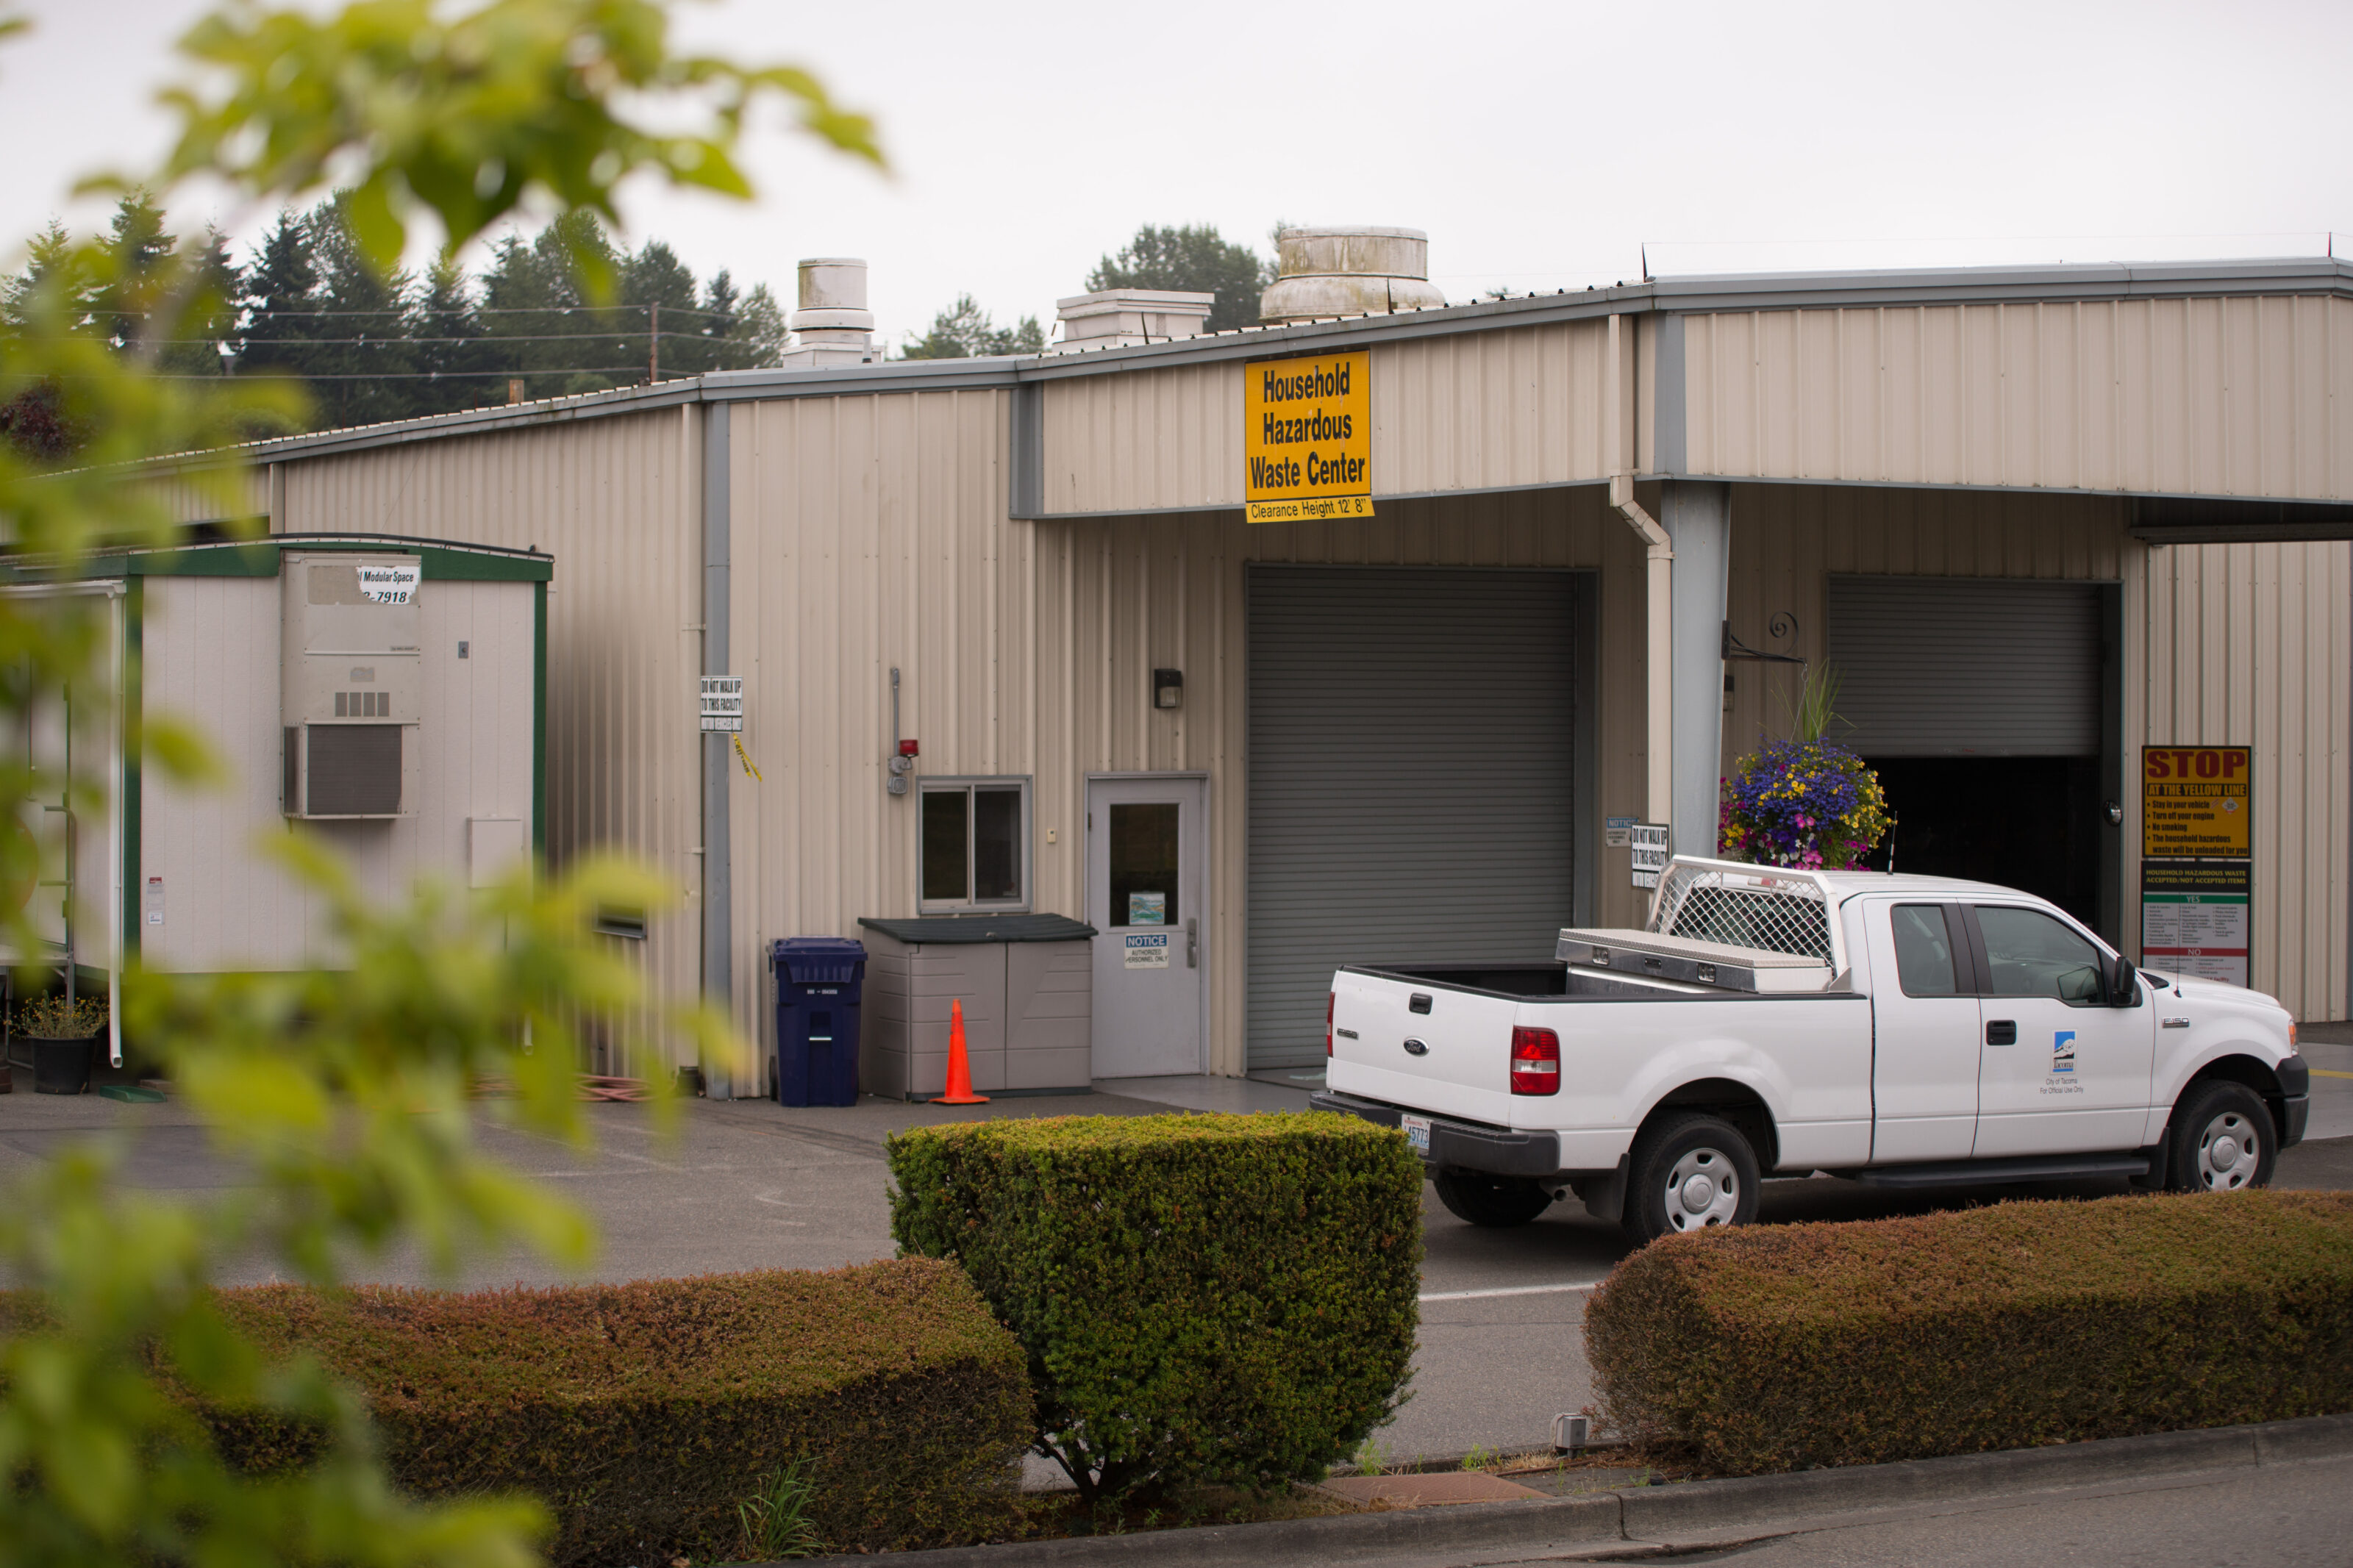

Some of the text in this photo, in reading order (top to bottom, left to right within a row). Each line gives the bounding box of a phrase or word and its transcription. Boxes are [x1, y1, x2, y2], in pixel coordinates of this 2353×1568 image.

[1263, 362, 1350, 403] Household
[1263, 408, 1352, 445] Hazardous
[1250, 451, 1365, 489] Waste Center
[1251, 504, 1298, 519] Clearance
[1302, 501, 1335, 517] Height
[364, 571, 392, 582] Modular
[393, 571, 413, 585] Space
[701, 680, 740, 693] DO NOT WALK UP
[701, 698, 741, 711] TO THIS FACILITY
[2146, 751, 2246, 778] STOP
[2149, 784, 2246, 796] AT THE YELLOW LINE
[2152, 801, 2165, 809] Stay
[2167, 801, 2172, 809] in
[2188, 801, 2210, 809] vehicle
[2153, 812, 2167, 820] Turn
[2168, 812, 2177, 820] off
[2193, 812, 2215, 820] engine
[2161, 823, 2188, 832] smoking
[1633, 828, 1667, 845] DO NOT WALK UP
[2153, 834, 2164, 842] The
[2195, 846, 2224, 854] unloaded
[2226, 846, 2235, 854] for
[1633, 849, 1668, 866] TO THIS FACILITY
[1128, 936, 1165, 946] NOTICE
[1407, 1041, 1421, 1052] Ford
[2054, 1059, 2073, 1069] Tacoma
